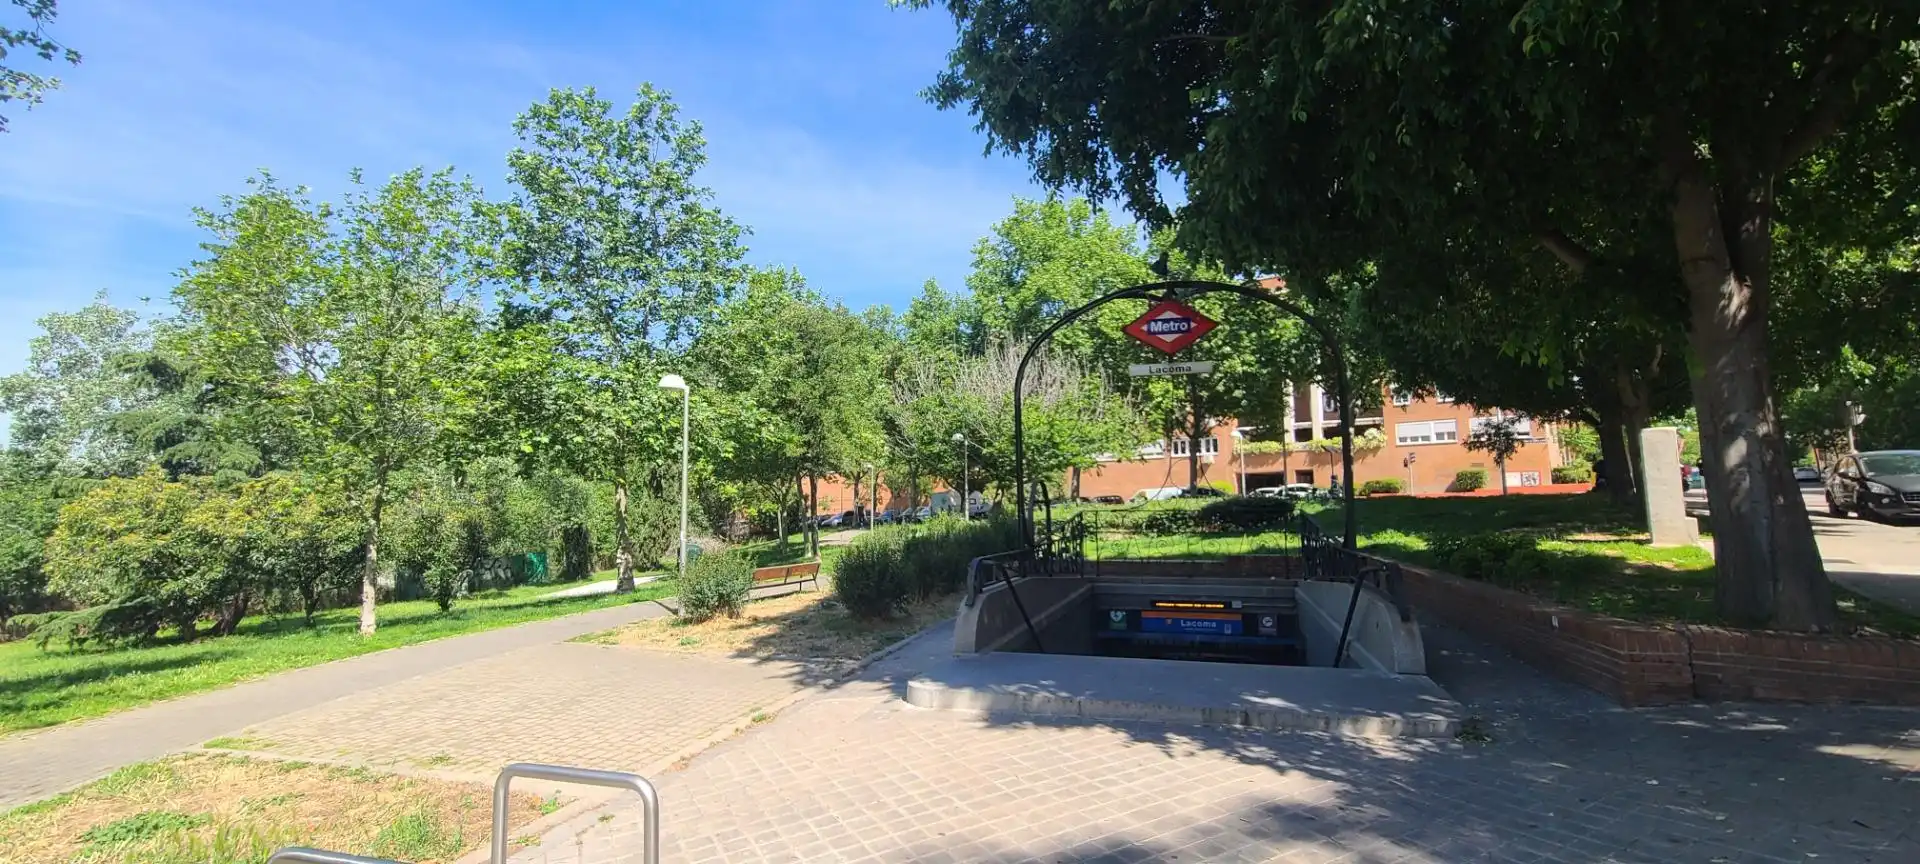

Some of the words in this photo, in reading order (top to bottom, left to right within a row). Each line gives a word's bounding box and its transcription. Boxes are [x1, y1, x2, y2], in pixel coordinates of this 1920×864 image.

[1150, 321, 1188, 332] Metro
[1149, 365, 1192, 374] Lacoma
[1180, 619, 1217, 628] Lacoma
